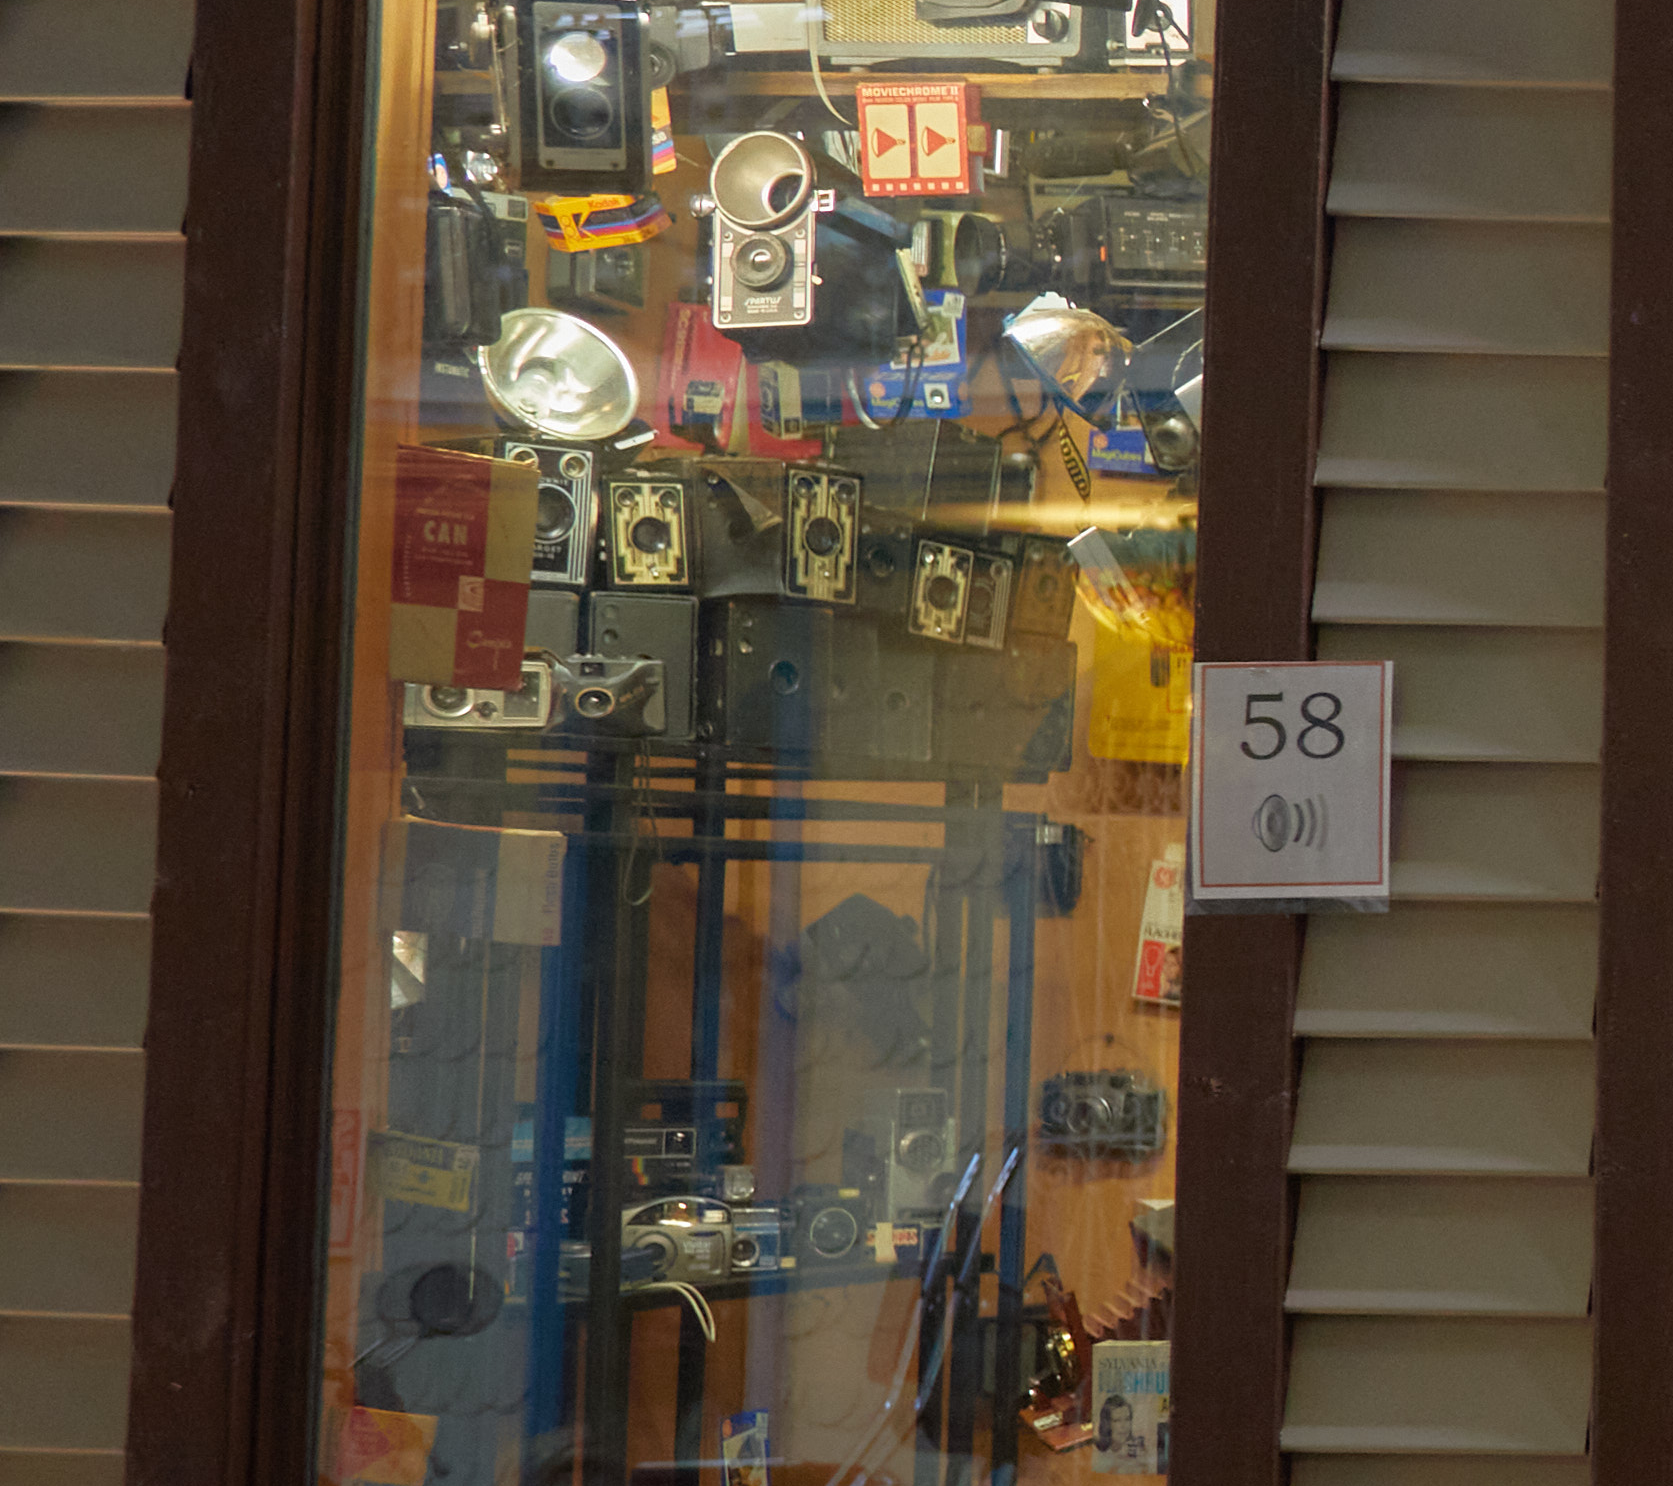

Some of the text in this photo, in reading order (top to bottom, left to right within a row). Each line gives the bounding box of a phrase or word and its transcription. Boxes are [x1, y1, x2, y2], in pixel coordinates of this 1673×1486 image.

[861, 86, 948, 98] MOVIECHROME
[423, 520, 468, 546] CAN
[1239, 691, 1347, 760] 58
